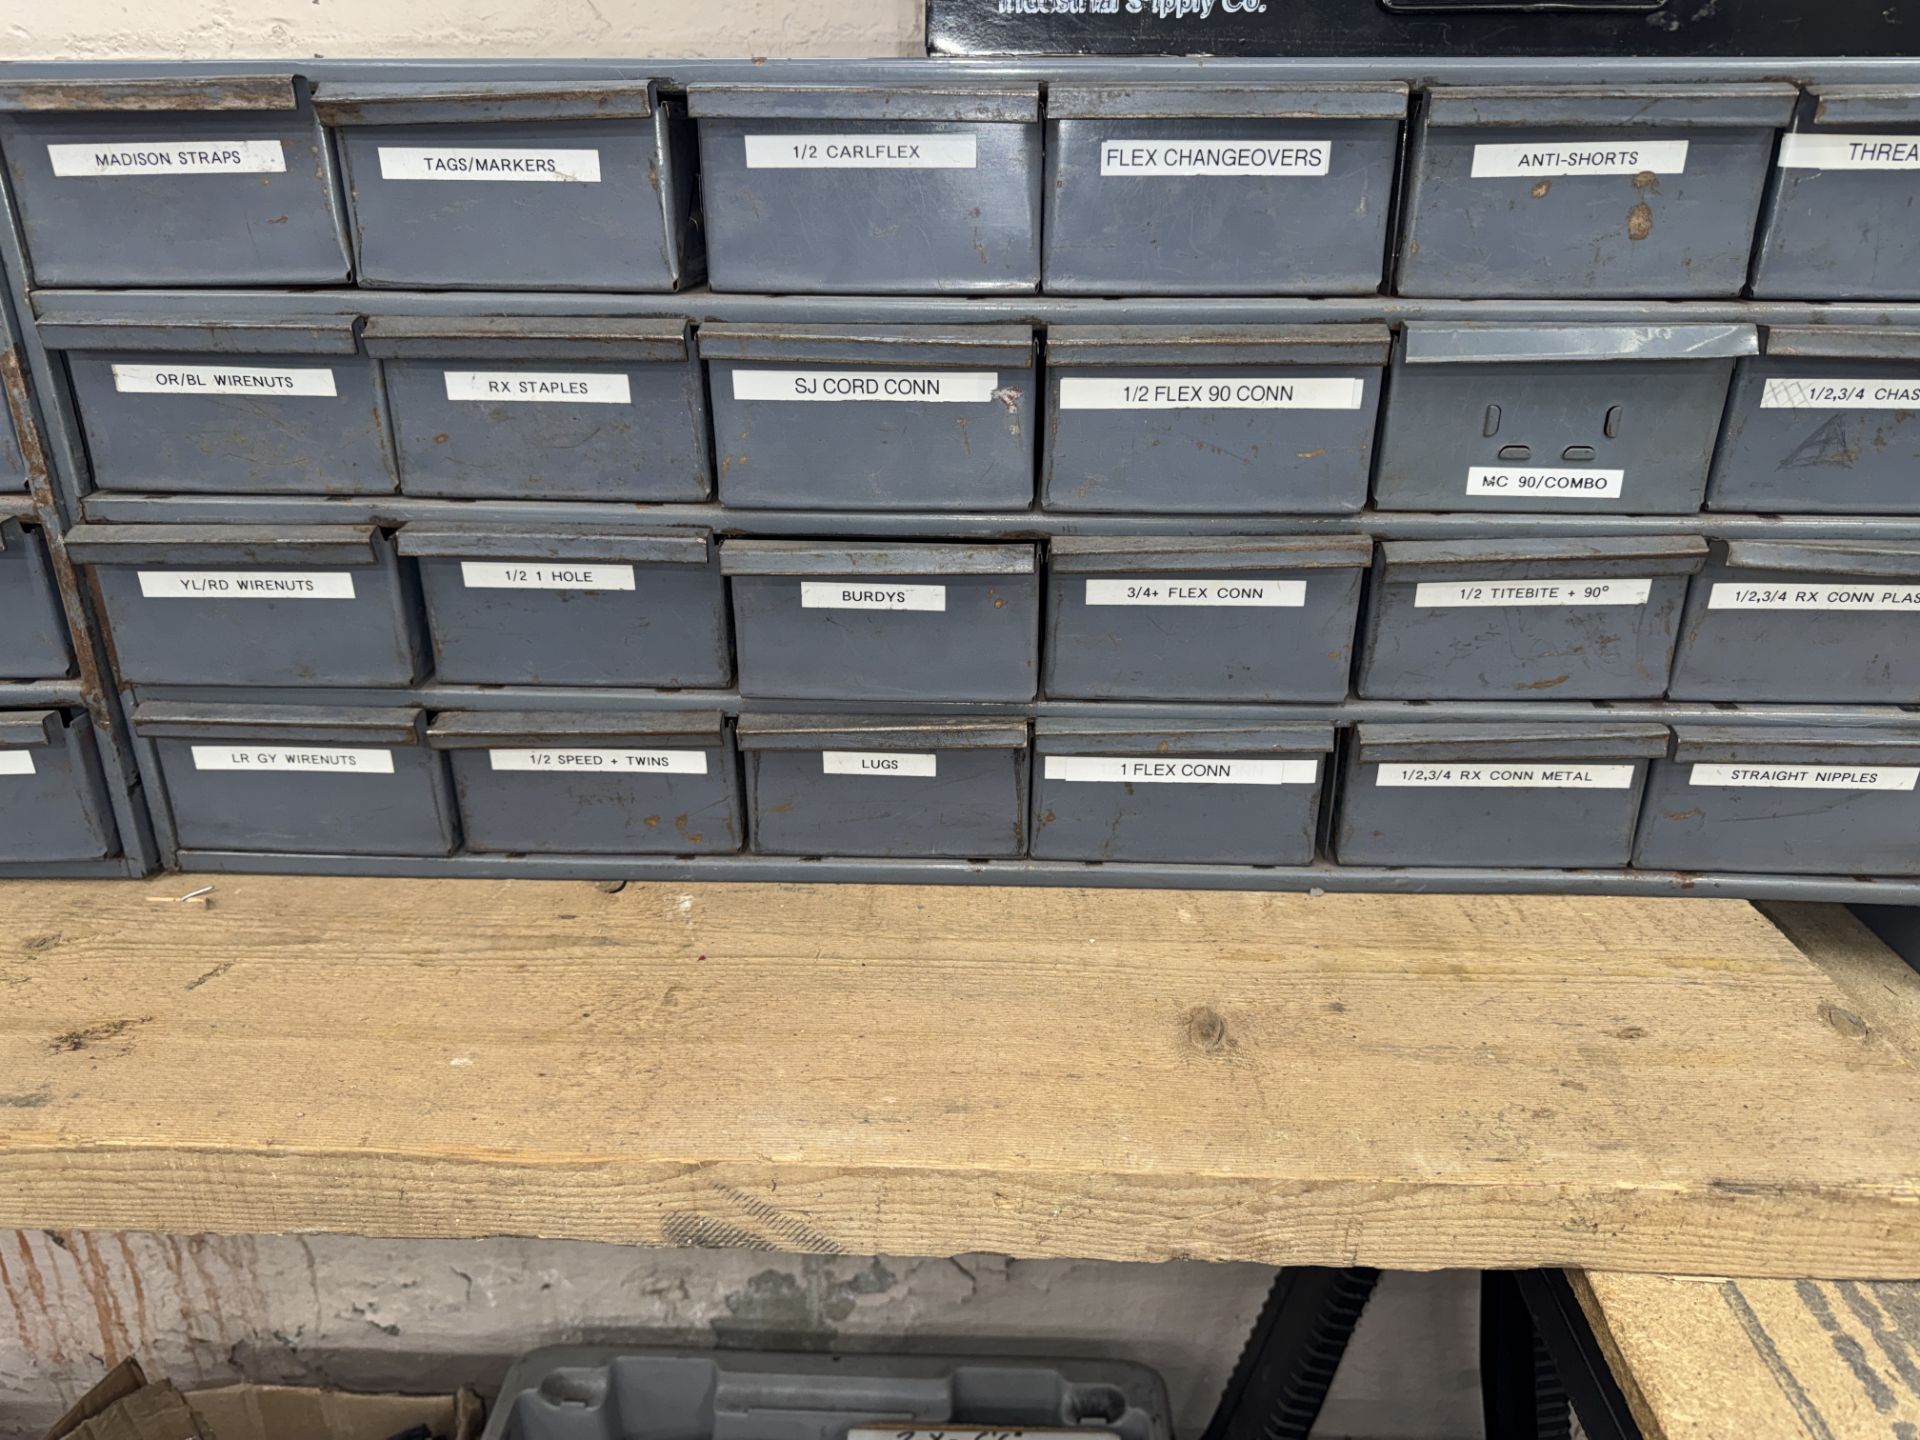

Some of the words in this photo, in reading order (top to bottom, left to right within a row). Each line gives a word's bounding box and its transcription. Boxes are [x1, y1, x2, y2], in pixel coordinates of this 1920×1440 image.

[1222, 0, 1266, 12] Co.
[95, 152, 172, 166] MADISON
[178, 150, 241, 165] STRAPS
[793, 144, 817, 160] 1/2
[826, 144, 920, 159] CARLFLEX
[1107, 148, 1158, 167] FLEX
[1164, 148, 1322, 167] CHANGEOVERS
[1517, 151, 1639, 167] ANTI-SHORTS
[423, 157, 556, 173] TAGS/MARKERS
[155, 372, 207, 387] OR/BL
[213, 374, 294, 388] WIRENUTS
[794, 377, 817, 394] SJ
[822, 377, 879, 395] CORD
[884, 378, 940, 395] CONN
[488, 381, 511, 393] RX
[518, 381, 588, 394] STAPLES
[1124, 385, 1149, 402] 1/2
[1154, 385, 1203, 402] FLEX
[1208, 385, 1231, 402] 90
[1236, 384, 1294, 402] CONN
[1810, 386, 1865, 402] 1/2,3/4
[1482, 475, 1509, 488] MC
[1518, 475, 1608, 490] 90/COMBO
[505, 569, 527, 582] 1/2
[536, 571, 542, 581] 1
[551, 571, 593, 583] HOLE
[180, 578, 229, 591] YL/RD
[236, 579, 314, 591] WIRENUTS
[842, 590, 905, 603] BURDYS
[1127, 586, 1159, 599] 3/4+
[1168, 587, 1208, 599] FLEX
[1216, 587, 1263, 599] CONN
[1460, 587, 1483, 600] 1/2
[1490, 587, 1560, 599] TITEBITE
[1736, 590, 1787, 604] 1/2,3/4
[1794, 591, 1819, 602] RX
[1827, 591, 1875, 603] CONN
[231, 753, 250, 763] LR
[257, 753, 277, 764] GY
[285, 754, 356, 766] WIRENUTS
[530, 753, 551, 765] 1/2
[557, 754, 603, 766] SPEED
[625, 756, 669, 767] TWINS
[861, 759, 899, 770] LUGS
[1121, 763, 1127, 776] 1
[1133, 763, 1176, 776] FLEX
[1181, 763, 1231, 777] CONN
[1402, 769, 1451, 782] 1/2,3/4
[1459, 770, 1481, 780] RX
[1489, 770, 1534, 781] CONN
[1541, 771, 1592, 782] METAL
[1731, 769, 1809, 781] STRAIGHT
[1815, 772, 1878, 784] NIPPLES
